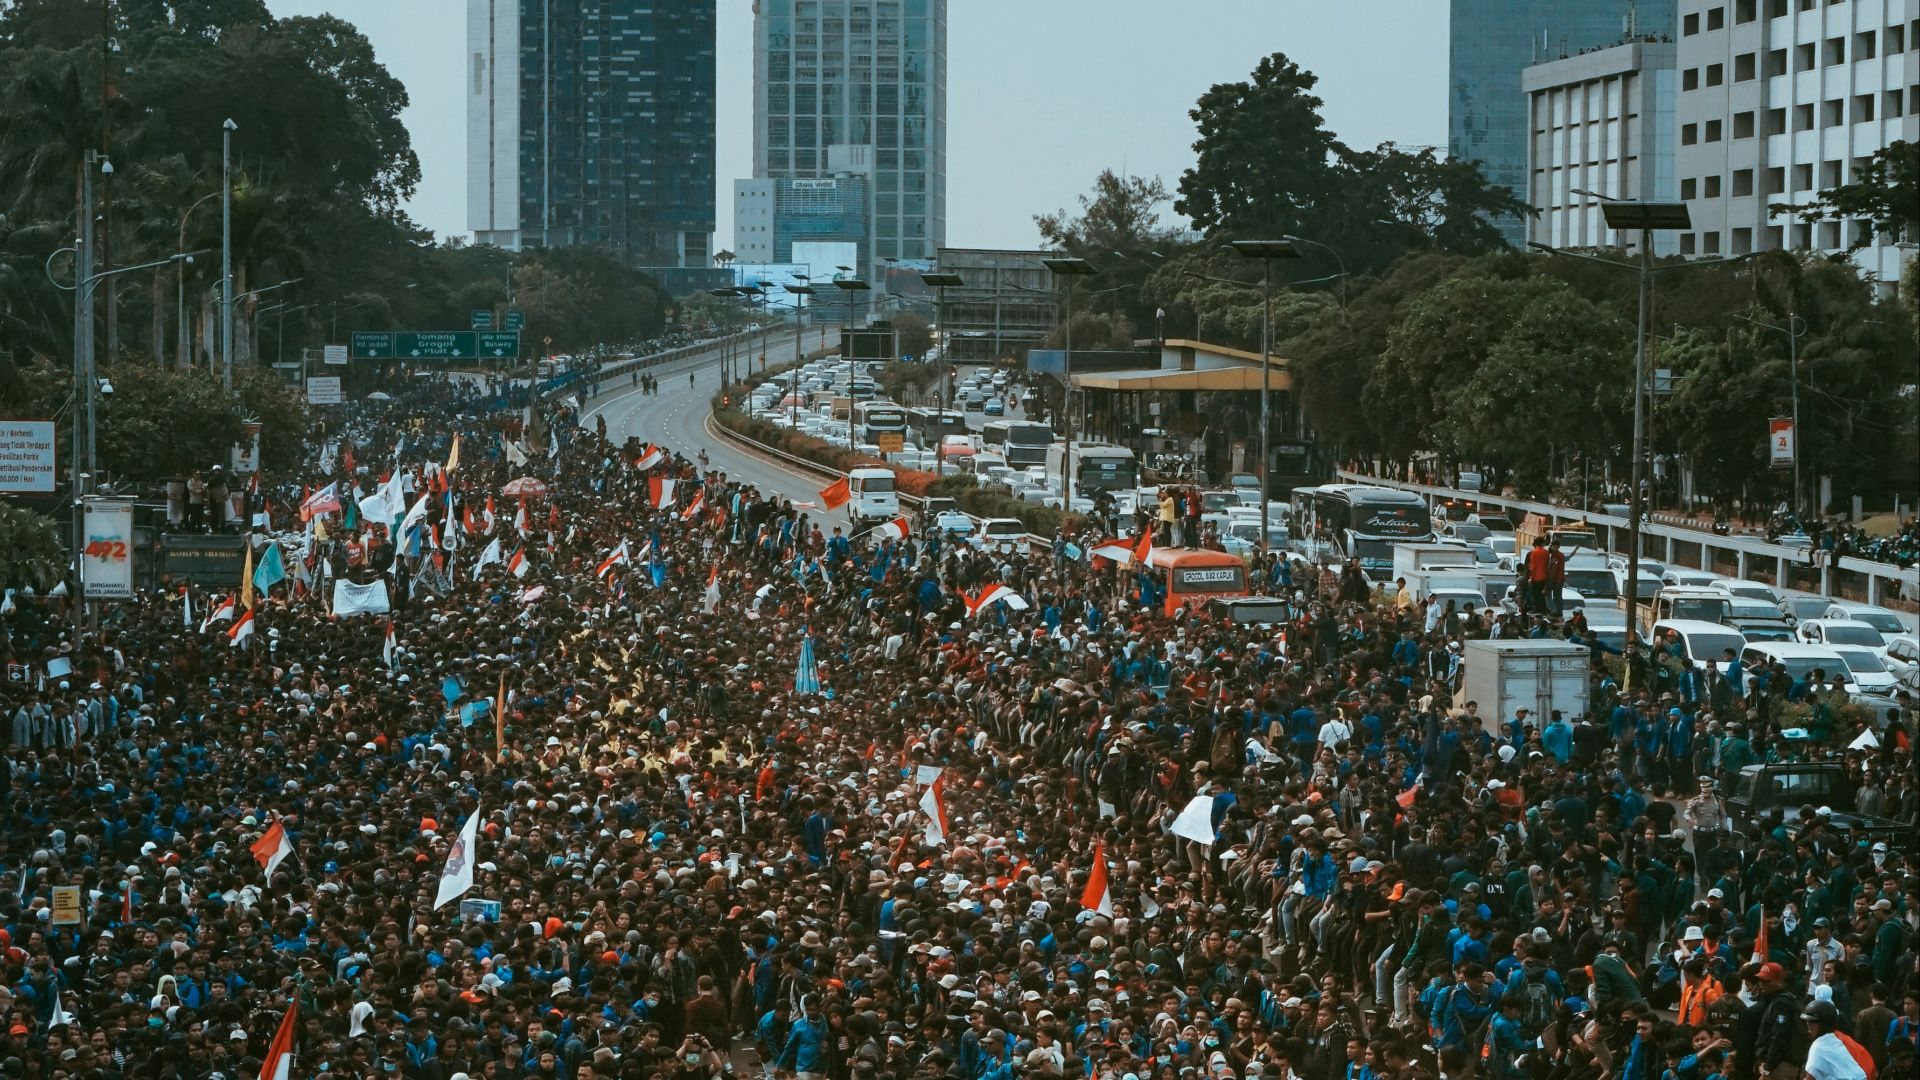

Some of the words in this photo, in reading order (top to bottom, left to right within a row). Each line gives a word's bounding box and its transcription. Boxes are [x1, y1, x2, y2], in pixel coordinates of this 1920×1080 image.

[484, 341, 512, 349] Busway
[10, 430, 34, 438] Berhenti
[26, 442, 50, 450] Terdapat
[0, 452, 22, 460] Fasilitas
[22, 464, 53, 472] Penderekan
[23, 475, 35, 483] Hari
[86, 541, 126, 558] 492
